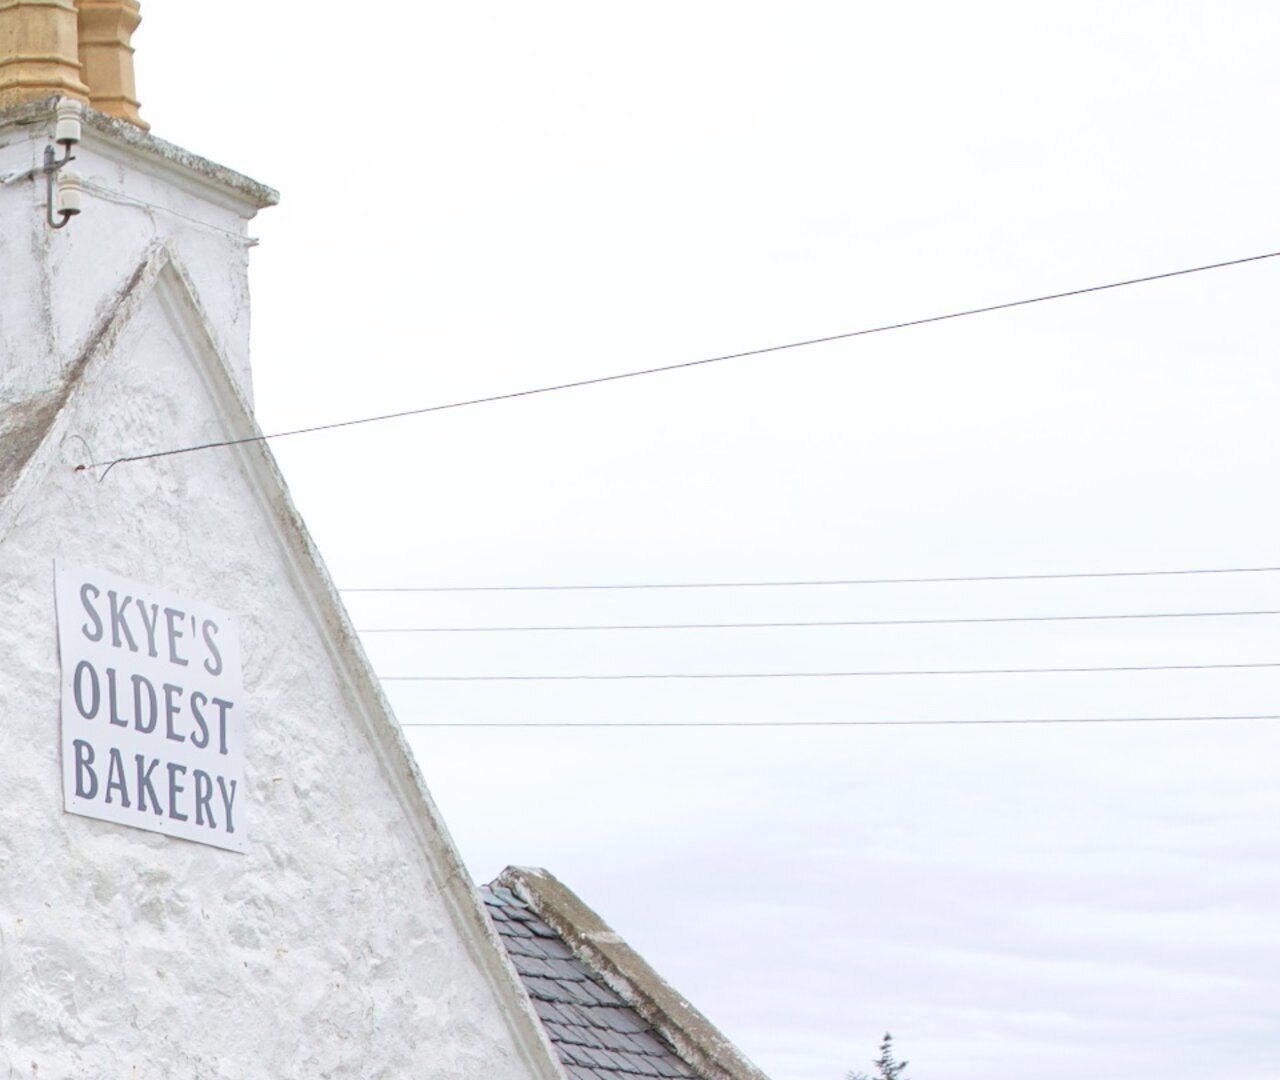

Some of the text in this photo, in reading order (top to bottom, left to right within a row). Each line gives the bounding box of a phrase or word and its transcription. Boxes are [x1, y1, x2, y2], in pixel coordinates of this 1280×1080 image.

[79, 583, 223, 677] SKYE'S
[73, 660, 234, 755] OLDEST
[72, 738, 237, 834] BAKERY
